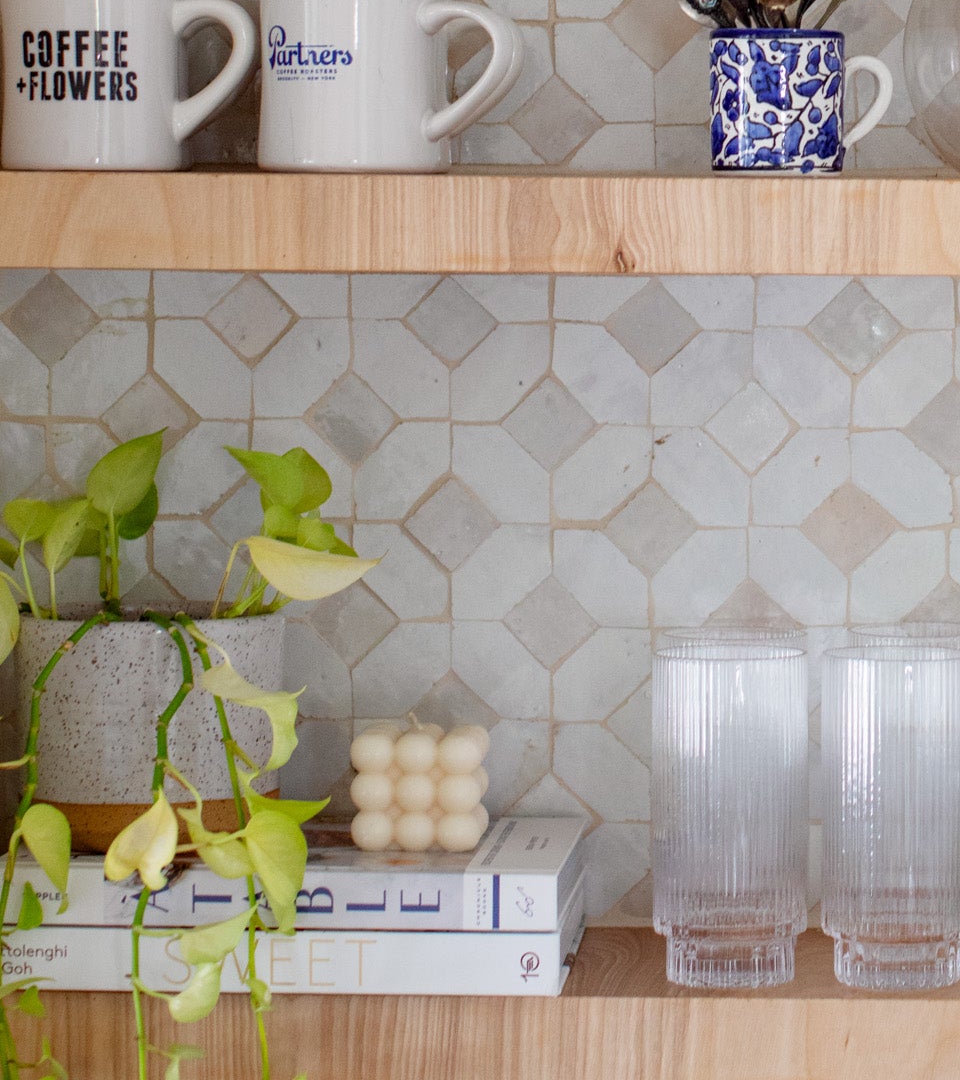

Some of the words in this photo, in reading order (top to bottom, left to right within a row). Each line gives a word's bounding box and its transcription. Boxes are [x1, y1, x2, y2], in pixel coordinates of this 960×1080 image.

[22, 30, 128, 68] COFFEE
[268, 25, 353, 70] Partners
[17, 71, 138, 101] +FLOWERS
[0, 944, 68, 961] tolenghi
[2, 961, 33, 975] Goh
